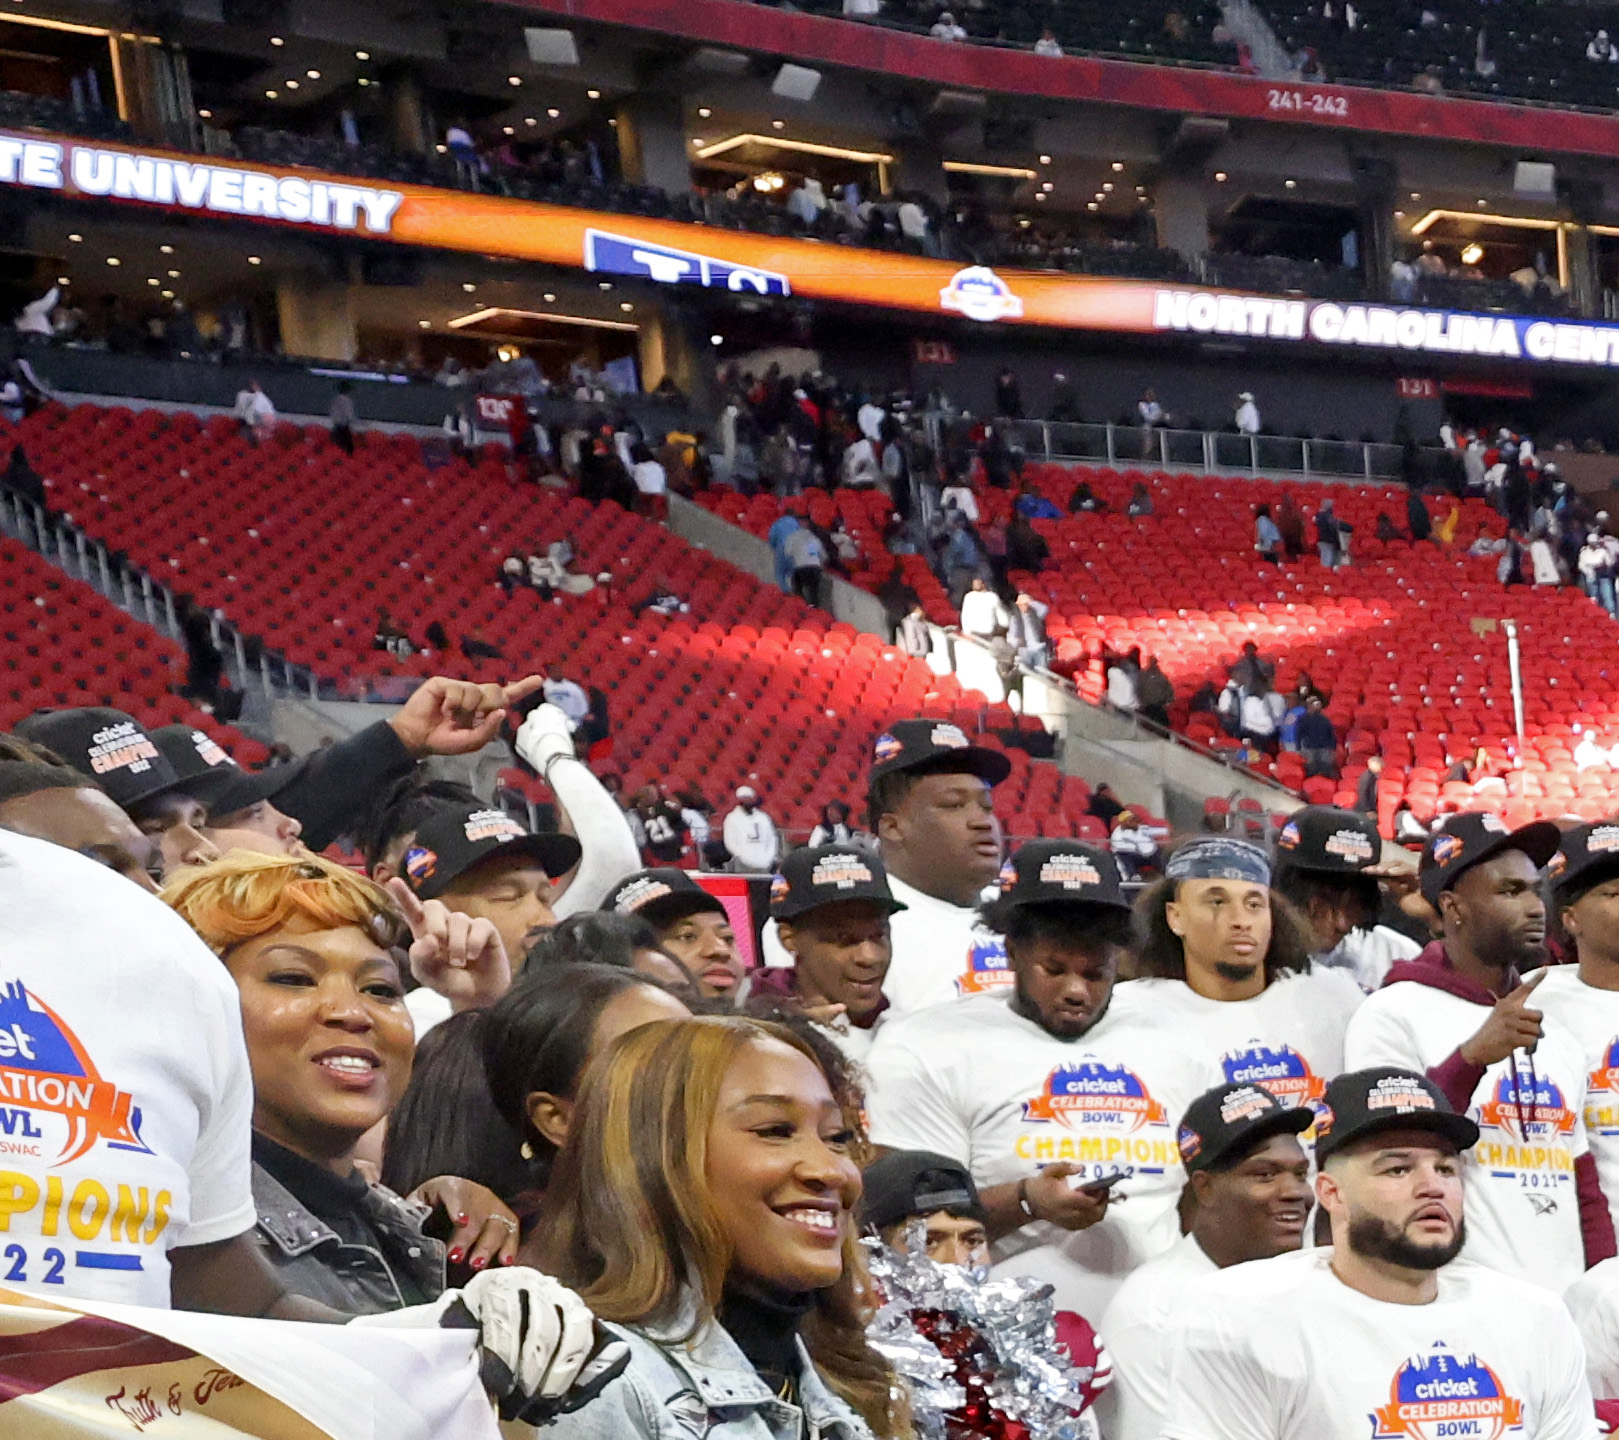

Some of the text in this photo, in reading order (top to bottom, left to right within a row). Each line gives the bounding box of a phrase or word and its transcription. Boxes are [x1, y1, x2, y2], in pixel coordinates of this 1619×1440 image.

[1269, 90, 1348, 115] 241-242
[73, 149, 402, 234] UNIVERSITY
[1156, 294, 1304, 339] NORTH
[1310, 306, 1520, 355] CAROLINA
[1050, 853, 1088, 867] cricket
[1232, 1060, 1289, 1080] cricket
[1066, 1077, 1128, 1094] cricket
[1377, 1076, 1417, 1090] cricket
[1049, 1094, 1152, 1111] CELEBRATION
[1080, 1109, 1125, 1125] BOWL
[1015, 1133, 1183, 1164] CHAMPIONS
[1415, 1376, 1479, 1400] cricket
[1398, 1400, 1505, 1421] CELEBRATION
[1436, 1419, 1483, 1438] BOWL
